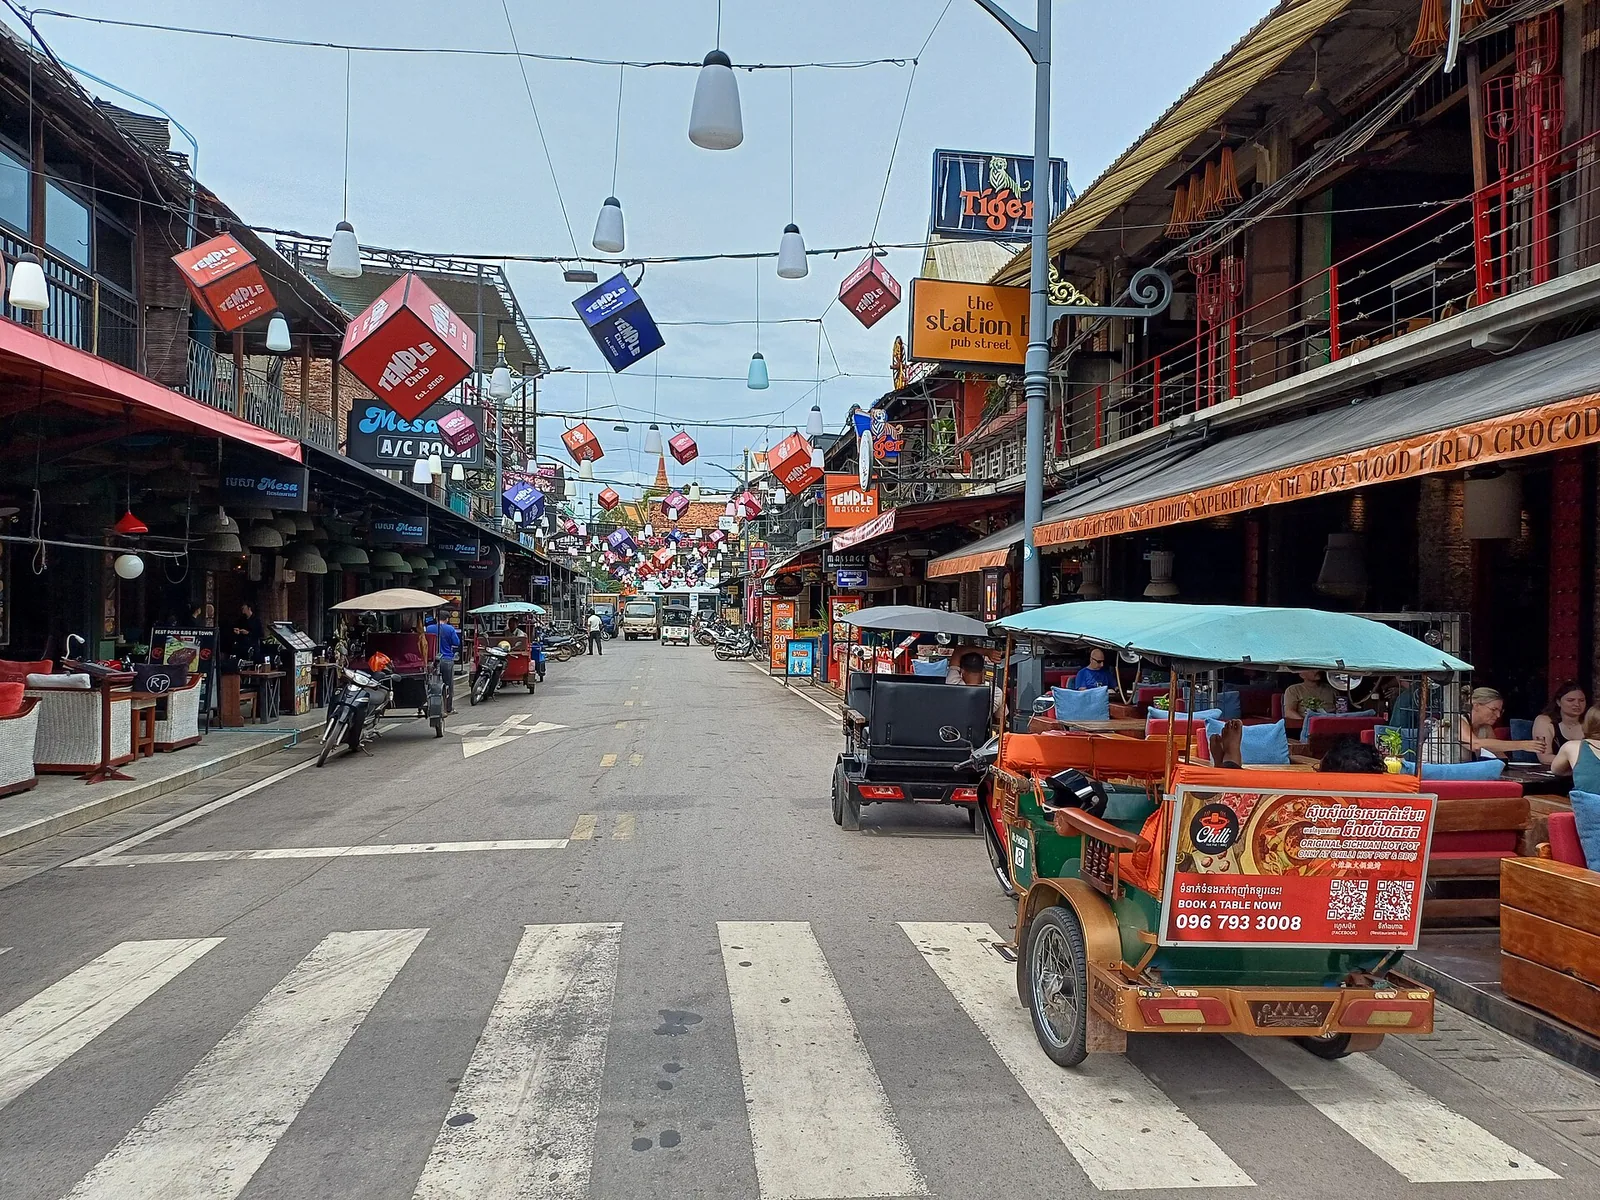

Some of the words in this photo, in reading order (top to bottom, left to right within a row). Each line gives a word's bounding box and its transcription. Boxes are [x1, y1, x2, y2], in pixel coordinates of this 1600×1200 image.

[960, 188, 1034, 231] Tiger
[191, 247, 238, 271] TEMPLE
[209, 258, 228, 269] Club
[218, 284, 265, 312] TEMPLE
[236, 299, 255, 311] Club
[585, 287, 627, 313] TEMPLE
[855, 287, 884, 313] TEMPLE
[968, 296, 994, 311] the
[926, 309, 1012, 336] station
[614, 317, 641, 357] TEMPLE
[950, 337, 971, 350] pub
[974, 338, 1012, 350] street
[378, 341, 437, 392] TEMPLE
[404, 367, 430, 387] Club
[414, 389, 429, 400] Est.
[426, 374, 445, 391] 2002
[359, 406, 440, 434] Mesa
[381, 439, 413, 457] A/C
[873, 435, 905, 459] ger
[785, 462, 811, 484] TEMPLE
[1129, 506, 1156, 528] GREAT
[1194, 484, 1262, 517] EXPERIENCE
[1279, 474, 1306, 498] THE
[1310, 464, 1346, 492] BEST
[1358, 449, 1411, 482] WOOD
[1419, 433, 1483, 470] FIRED
[1494, 406, 1600, 455] CROCOD
[257, 477, 298, 491] Mesa
[830, 490, 874, 506] TEMPLE
[395, 522, 424, 532] Mesa
[454, 543, 476, 552] Mesa
[827, 555, 866, 563] MASSAGE
[1196, 826, 1232, 844] Chilli
[1300, 839, 1341, 849] ORIGINAL
[1341, 840, 1381, 850] SICHUAN
[1381, 841, 1401, 851] HOT
[1401, 842, 1420, 851] POT
[1017, 849, 1023, 865] 8
[1298, 849, 1319, 858] ONLY
[1320, 850, 1331, 858] AT
[1331, 850, 1356, 859] CHILLI
[1356, 851, 1373, 859] HOT
[1373, 852, 1391, 860] POT
[1391, 852, 1397, 860] &
[1398, 852, 1417, 861] BBQ!
[1178, 900, 1207, 909] BOOK
[1209, 901, 1217, 909] A
[1219, 901, 1251, 910] TABLE
[1253, 901, 1282, 910] NOW!
[1176, 914, 1212, 929] 096
[1217, 915, 1250, 930] 793
[1255, 916, 1302, 931] 3008
